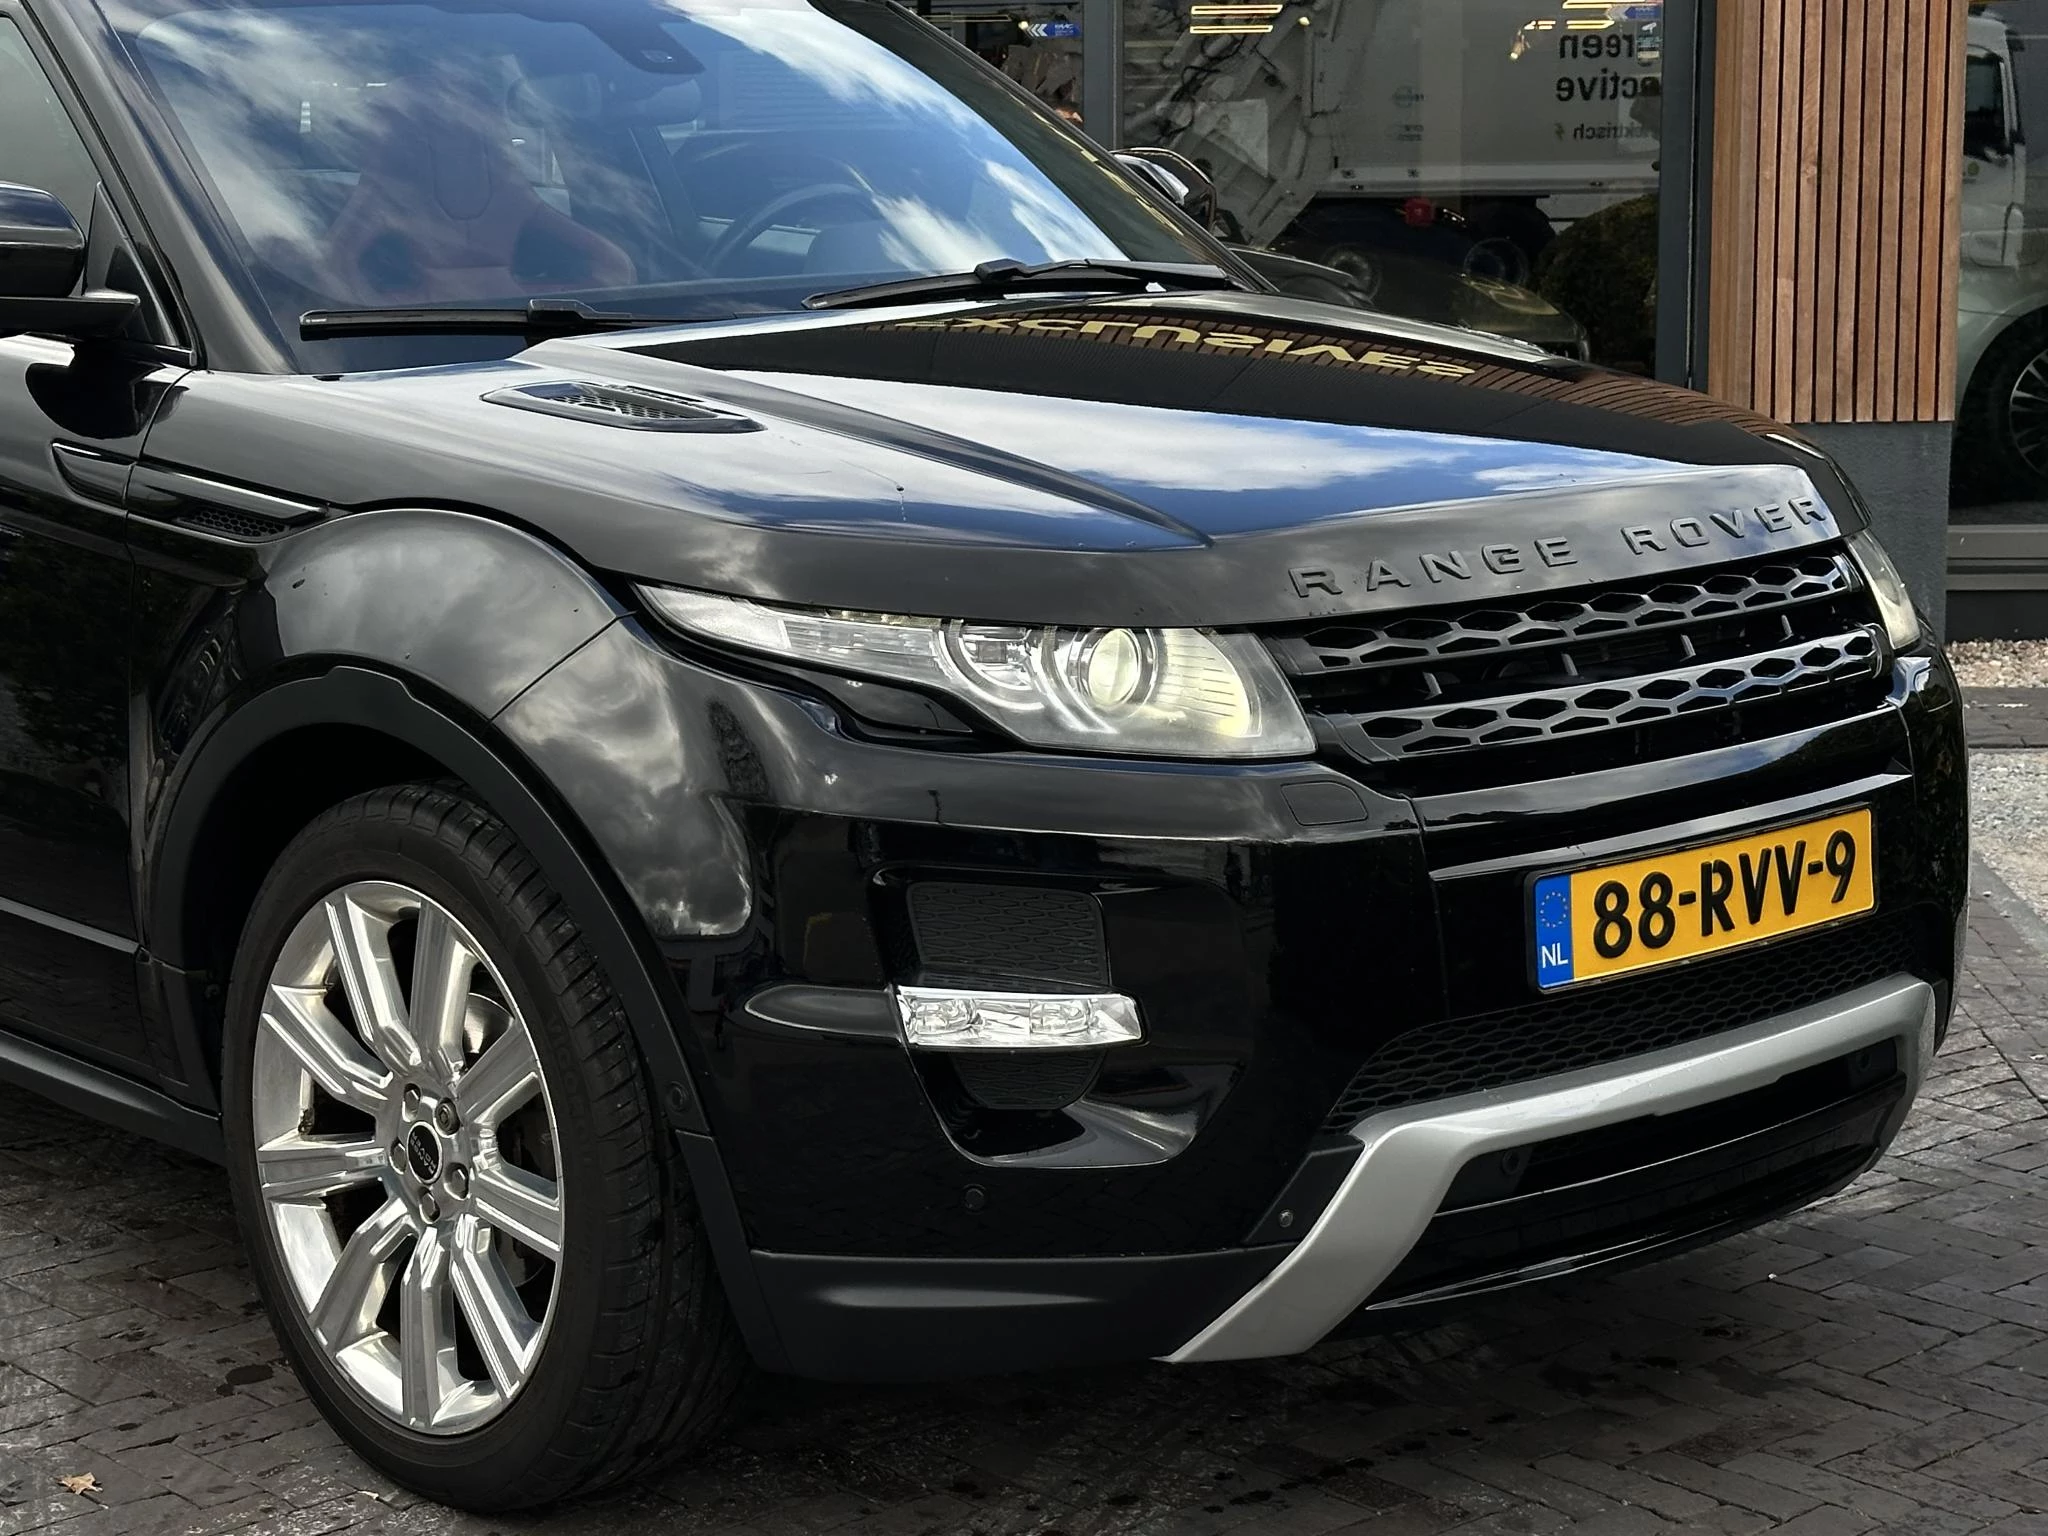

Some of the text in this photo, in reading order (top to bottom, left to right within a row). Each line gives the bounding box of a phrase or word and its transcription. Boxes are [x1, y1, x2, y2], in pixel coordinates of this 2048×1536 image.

[1288, 495, 1827, 598] RANGE ROVER
[1593, 829, 1856, 959] 88-RVV-9
[1541, 943, 1569, 969] NL
